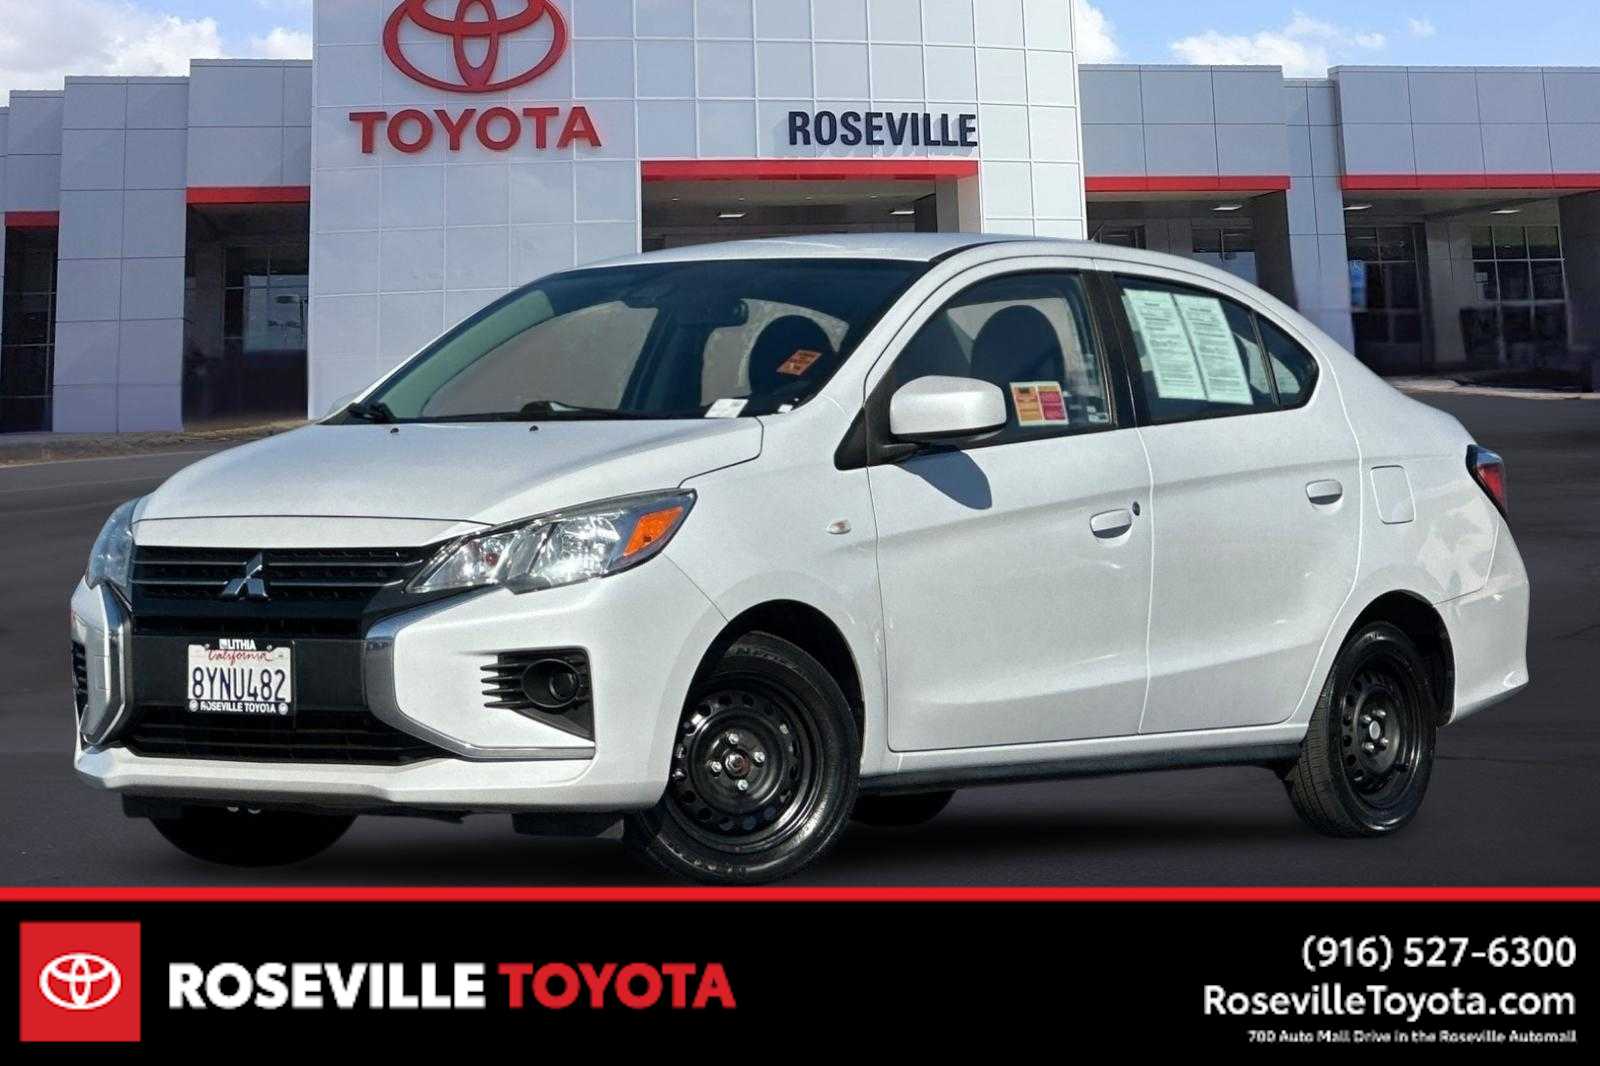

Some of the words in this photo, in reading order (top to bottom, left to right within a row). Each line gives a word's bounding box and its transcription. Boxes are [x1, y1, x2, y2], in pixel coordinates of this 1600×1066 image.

[350, 105, 602, 153] TOYOTA
[788, 110, 979, 148] ROSEVILLE
[227, 638, 257, 651] LITHIA
[192, 666, 286, 703] 8YNU482
[199, 701, 244, 713] ROSEVILLE
[245, 702, 277, 714] TOYOTA
